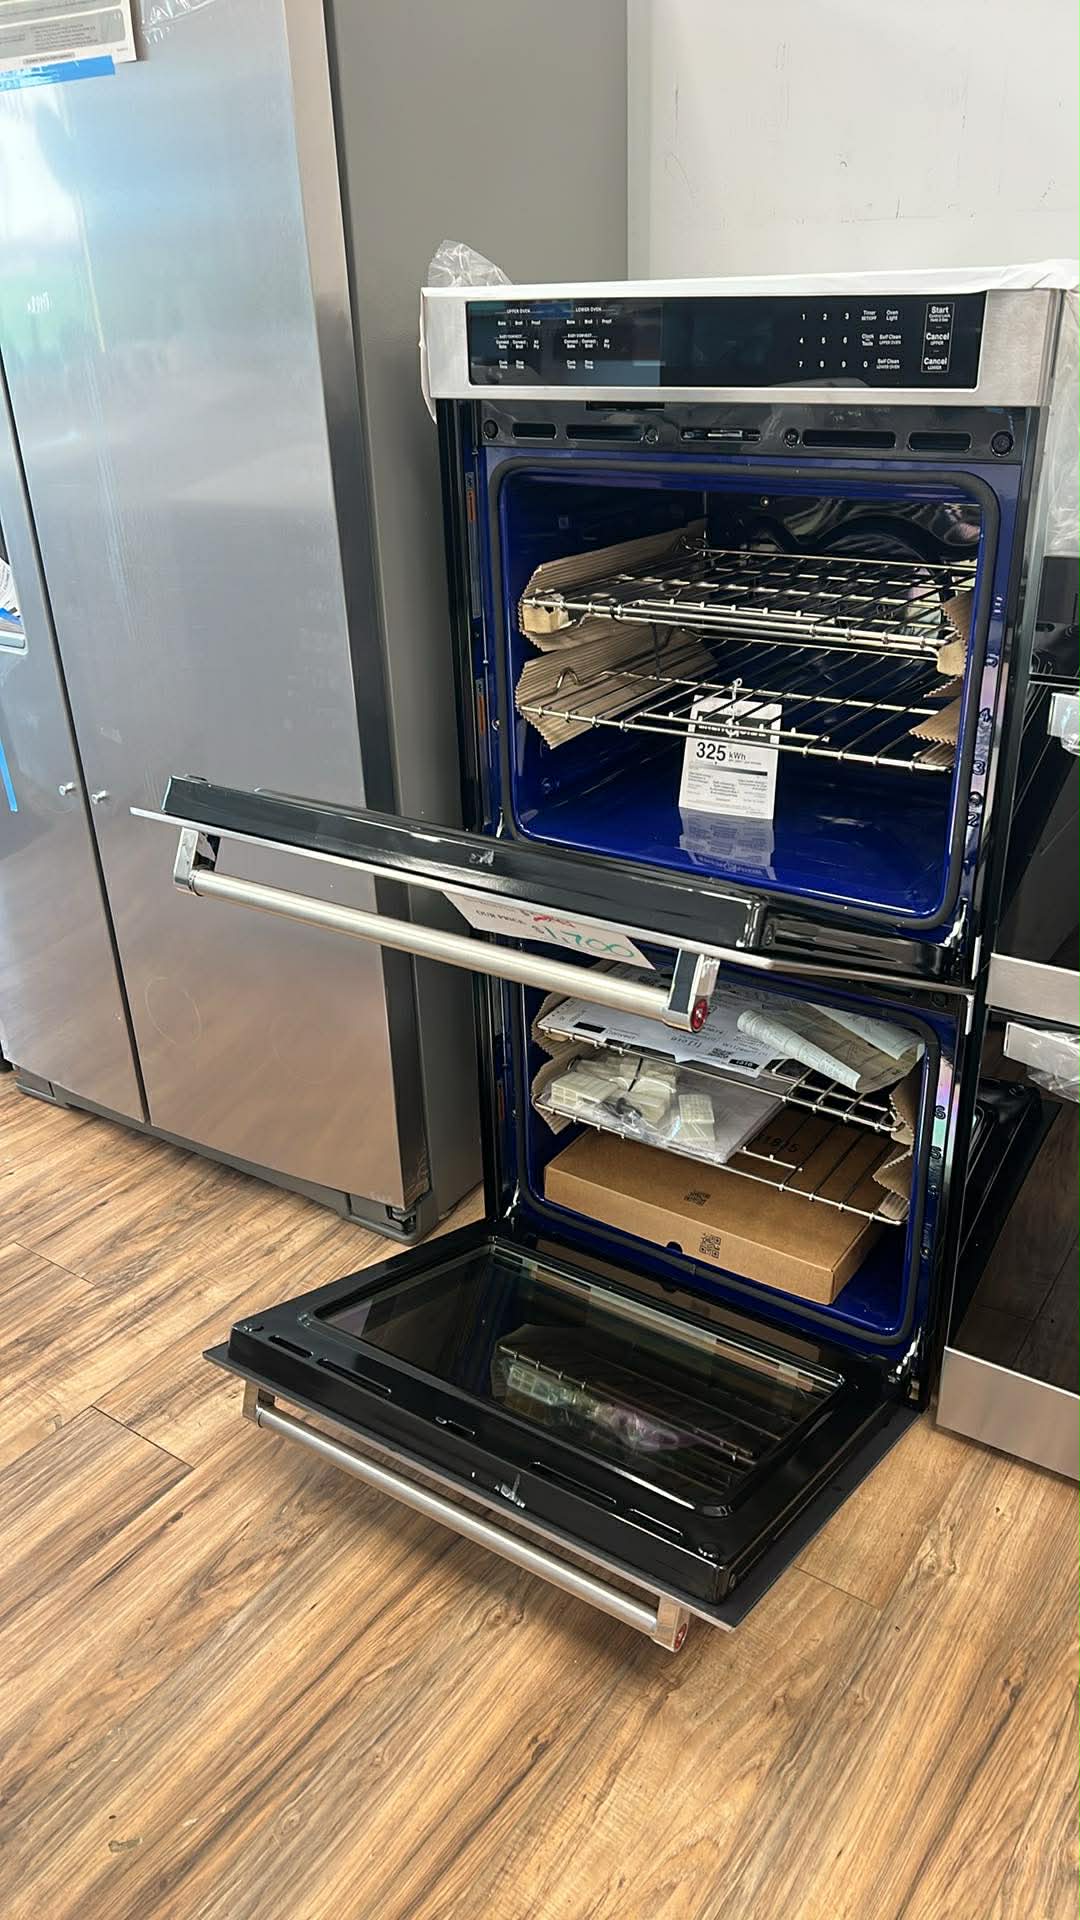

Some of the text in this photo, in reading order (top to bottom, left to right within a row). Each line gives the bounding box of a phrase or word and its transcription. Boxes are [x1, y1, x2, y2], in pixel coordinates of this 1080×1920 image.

[931, 305, 949, 314] Start
[925, 332, 950, 341] Cancel
[819, 360, 825, 368] 8
[841, 360, 847, 368] 9
[863, 360, 868, 368] 0
[923, 357, 947, 366] Cancel
[696, 741, 747, 762] 325 kWh
